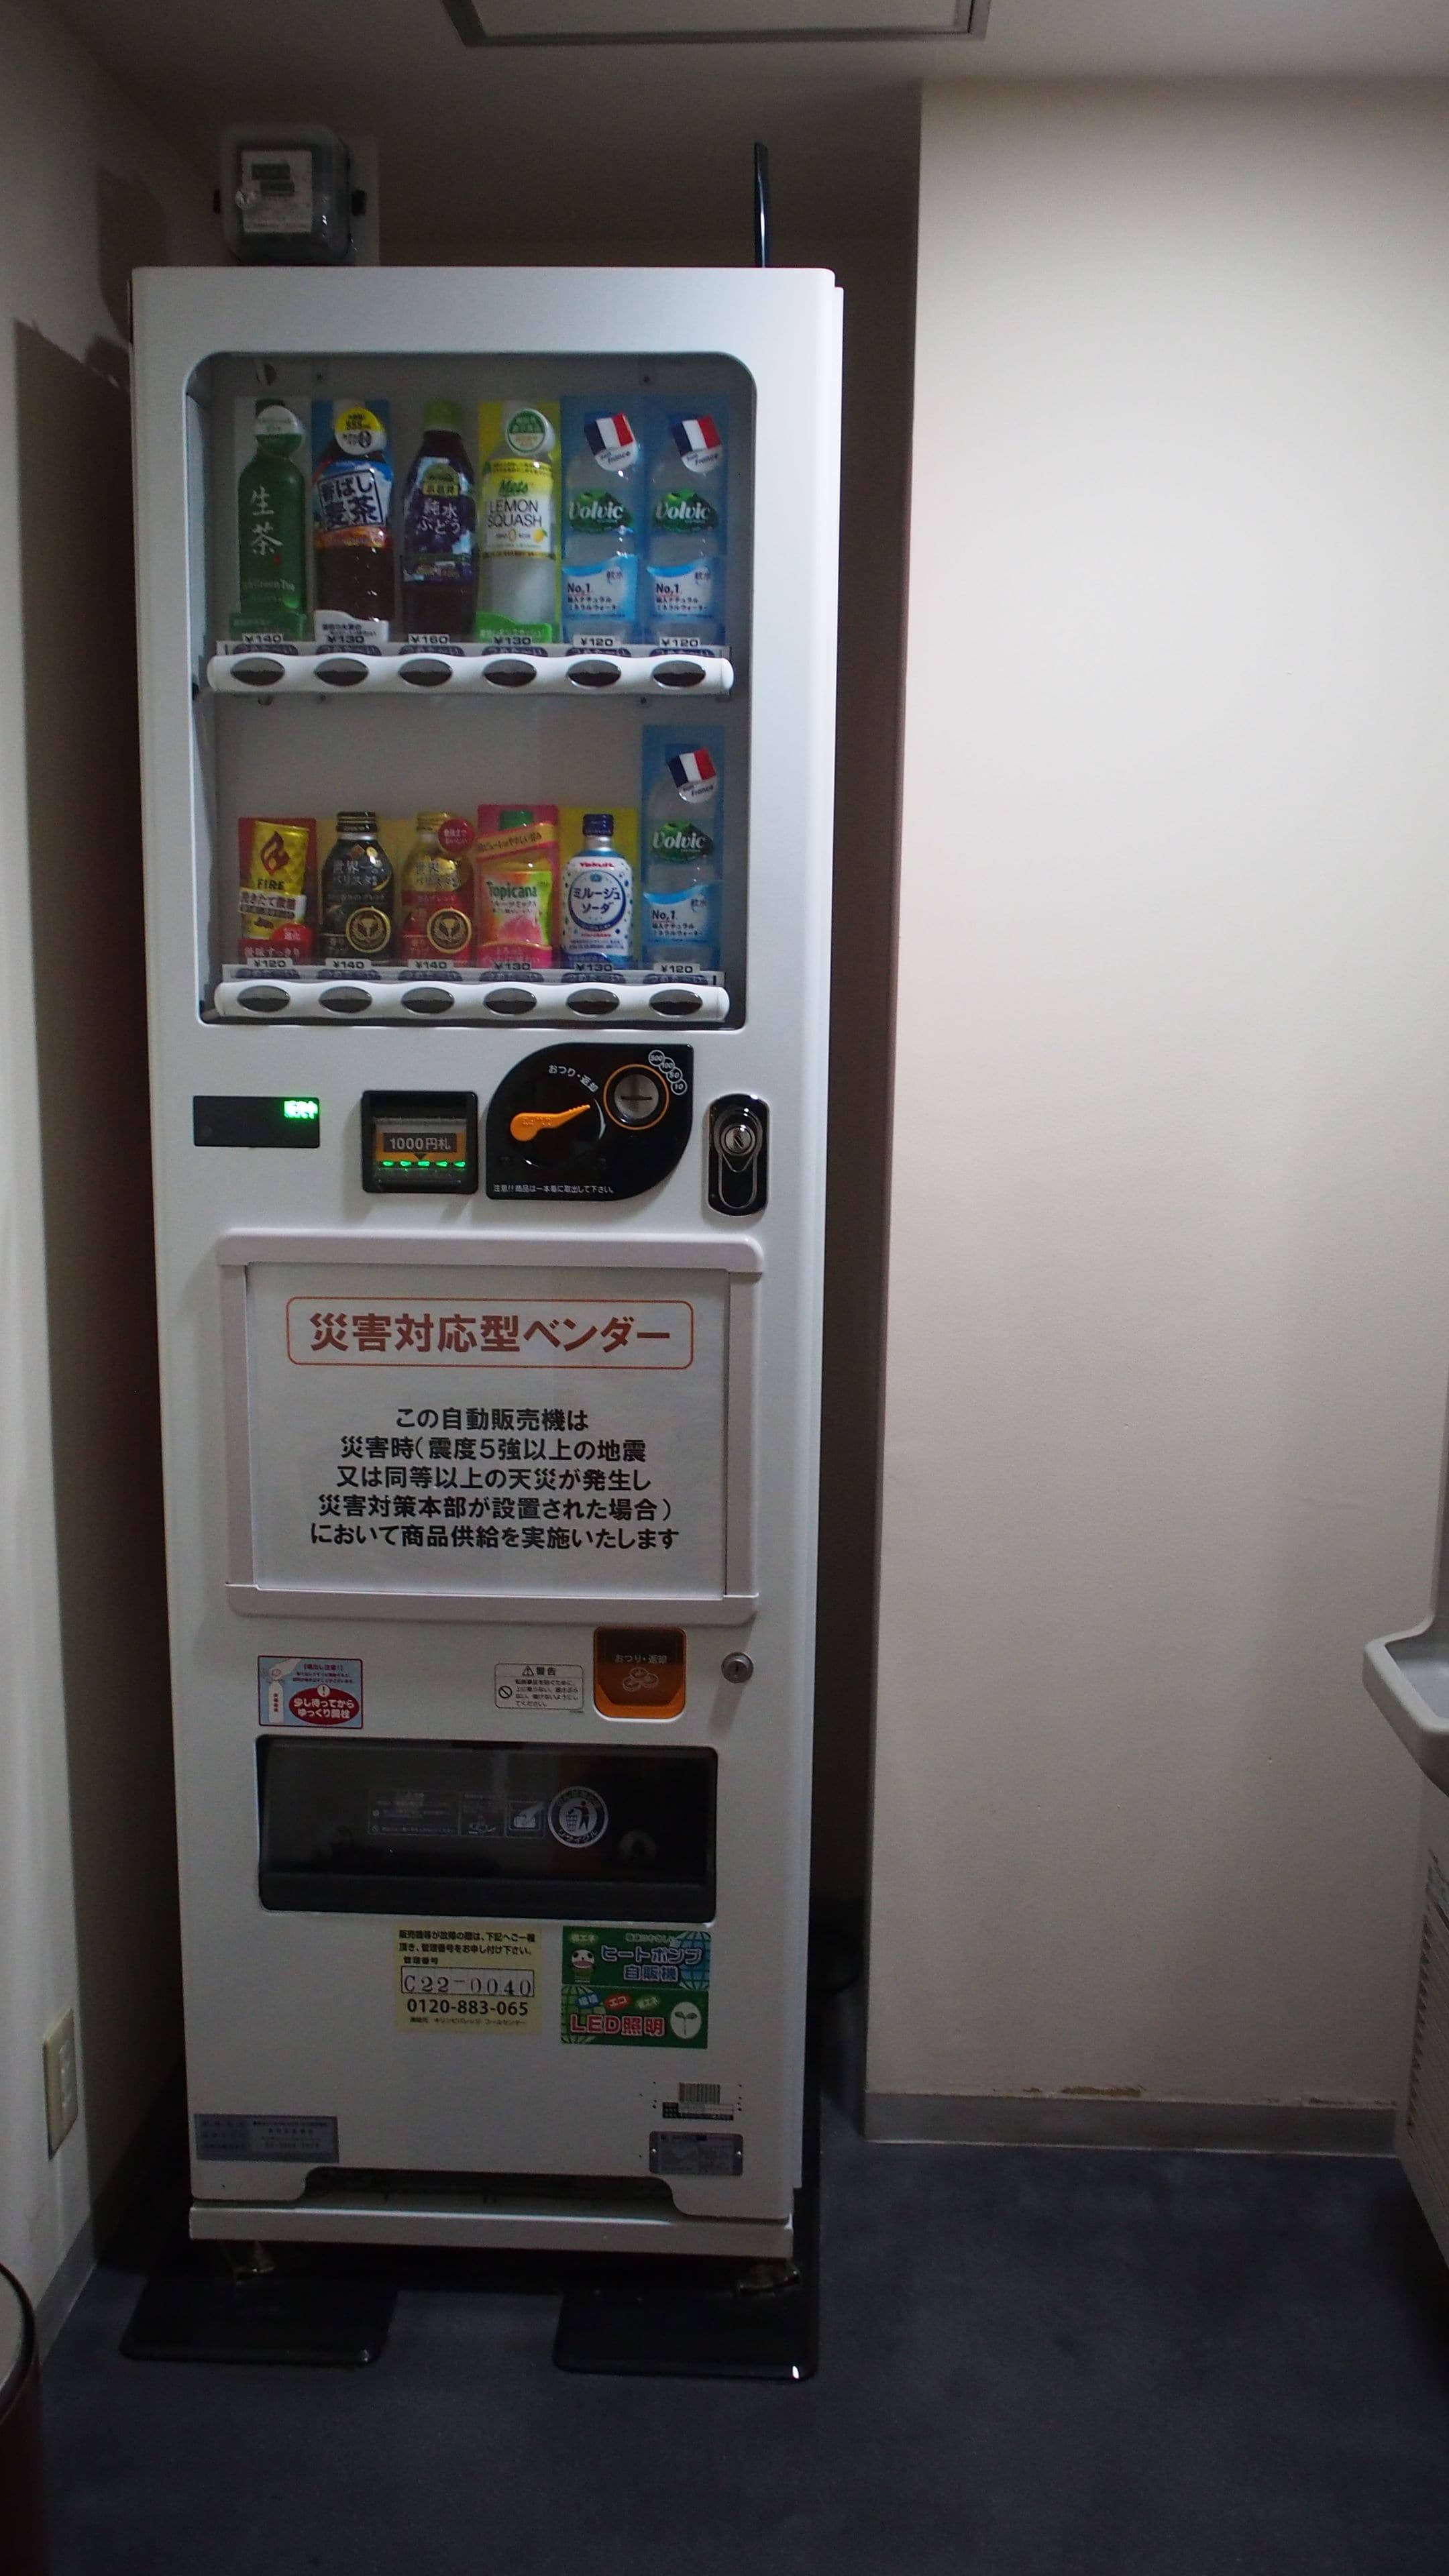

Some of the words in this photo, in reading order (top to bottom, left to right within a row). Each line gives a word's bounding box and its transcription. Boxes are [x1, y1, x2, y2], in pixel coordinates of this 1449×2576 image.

[489, 498, 538, 513] LEMON
[569, 500, 623, 520] Volvic
[655, 500, 711, 520] Volvic
[250, 485, 283, 555] 生茶
[416, 515, 461, 535] ぶどう
[487, 514, 542, 528] SQUASH
[568, 583, 591, 594] No.1
[656, 583, 679, 594] No.1
[327, 636, 364, 644] ¥130
[493, 637, 531, 645] ¥130
[652, 831, 706, 849] Volvic
[258, 878, 285, 890] FIRE
[573, 888, 621, 900] ミルージュ
[582, 902, 614, 914] ソーダ
[652, 910, 676, 920] No.1
[254, 960, 286, 968] ¥120
[333, 961, 364, 969] ¥140
[415, 961, 447, 969] ¥140
[494, 963, 530, 971] ¥130
[674, 1083, 684, 1091] 10
[390, 1137, 451, 1150] 1000円札
[309, 1312, 671, 1353] 災害対応型ベンダー
[396, 1407, 589, 1432] この自動販売機は
[336, 1466, 651, 1491] 又は同等以上の天災が発生し
[318, 1495, 672, 1521] 災害対策本部が設置された場合）
[310, 1522, 680, 1550] において商品供給を実施いたします
[536, 1667, 556, 1676] 警告
[600, 1944, 703, 1966] ヒートポンプ
[623, 1964, 679, 1982] 自販機
[407, 1998, 528, 2016] 0120-883-065
[608, 1995, 627, 2007] エコ
[570, 2014, 666, 2037] LED照明
